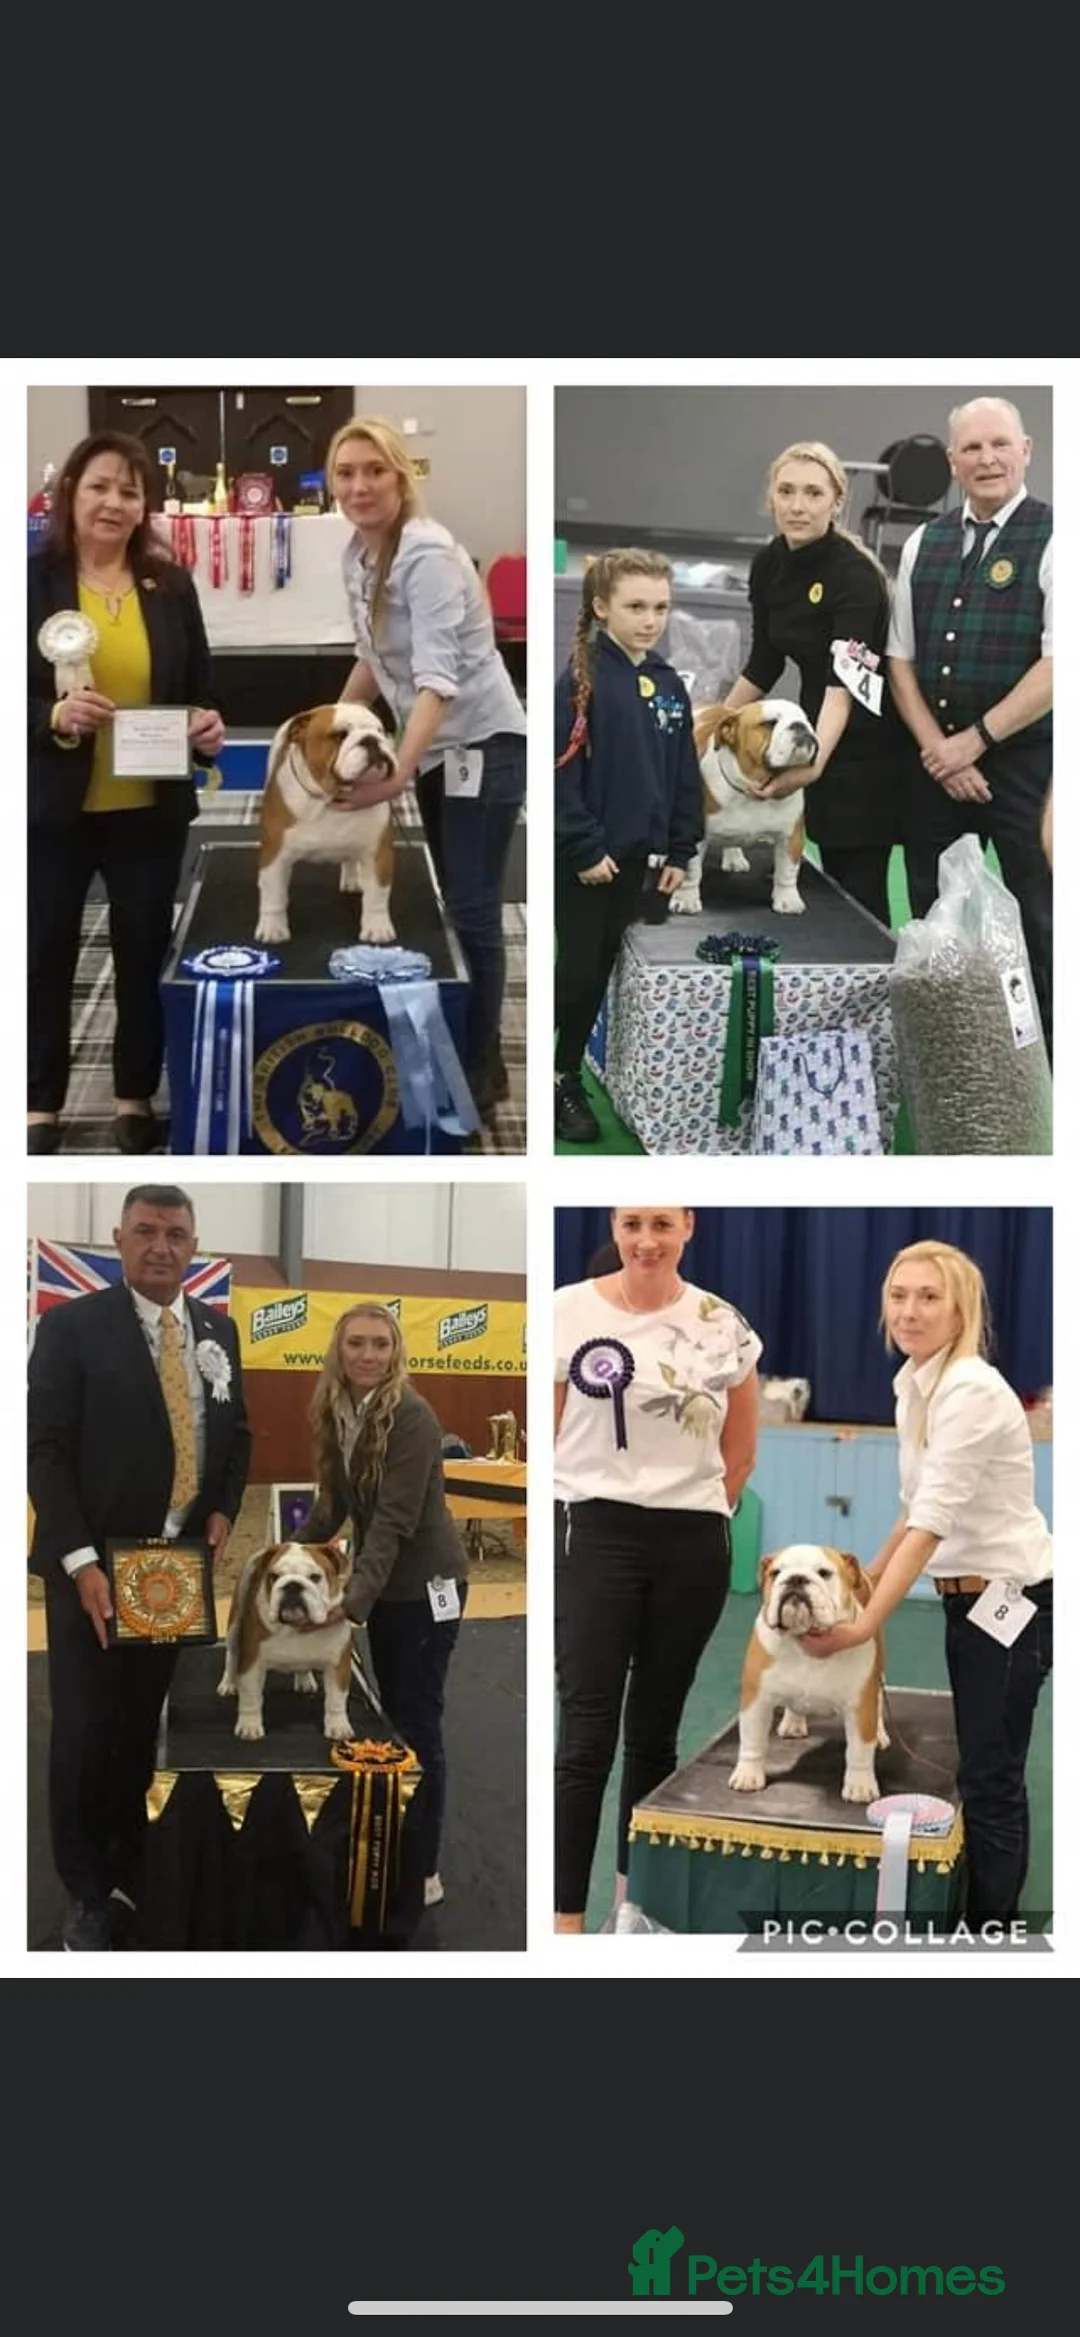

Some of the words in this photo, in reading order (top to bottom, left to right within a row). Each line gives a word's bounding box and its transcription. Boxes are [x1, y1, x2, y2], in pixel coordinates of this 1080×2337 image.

[858, 673, 870, 701] 4
[459, 765, 469, 782] 9
[746, 970, 757, 997] BEST
[746, 1000, 757, 1033] PUPPY
[746, 1037, 756, 1047] IN
[745, 1050, 756, 1081] SHOW
[252, 1298, 306, 1332] Baileys
[440, 1307, 487, 1339] Baileys
[438, 1594, 447, 1608] 8
[995, 1604, 1009, 1620] 8
